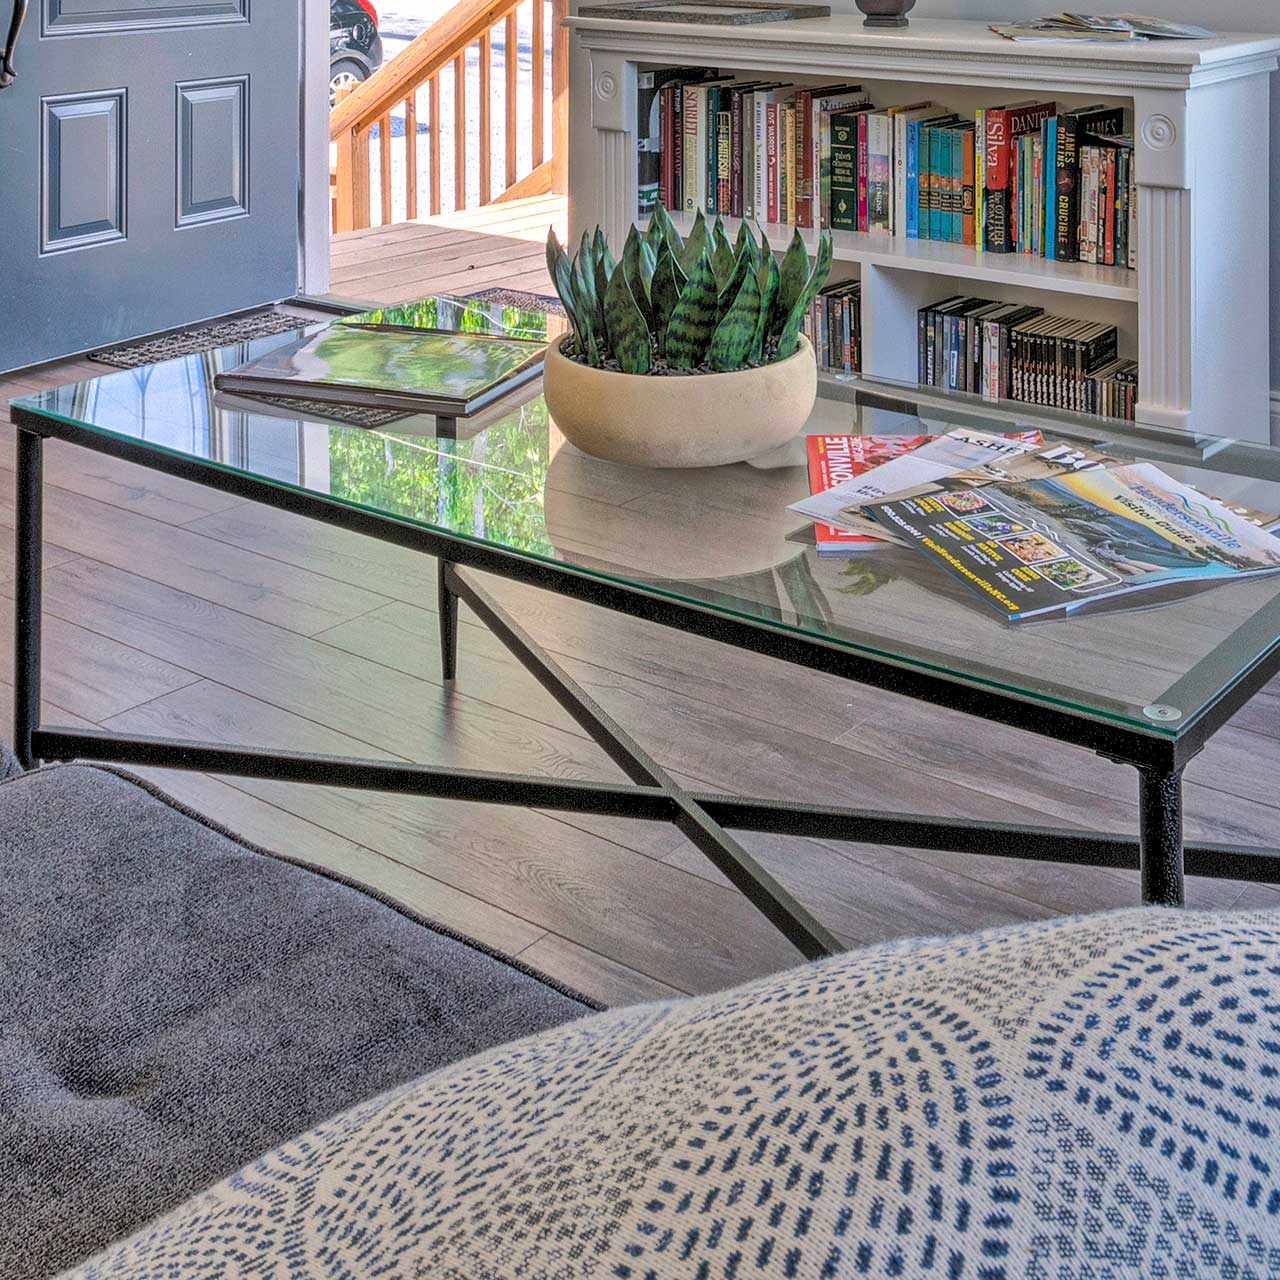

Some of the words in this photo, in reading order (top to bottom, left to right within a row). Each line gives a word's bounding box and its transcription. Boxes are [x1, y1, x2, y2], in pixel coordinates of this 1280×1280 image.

[684, 89, 698, 136] SCARLETT
[767, 108, 775, 125] LOVE
[718, 139, 729, 179] PATTERSON
[767, 125, 775, 155] WARRIOR
[796, 143, 804, 159] CODE
[987, 121, 1005, 169] Silva
[1057, 127, 1065, 168] ROLLINS
[1065, 132, 1075, 164] JAMES
[987, 194, 995, 241] WOMAN
[994, 204, 1005, 246] OTHER
[1058, 195, 1069, 244] CRUCIBLE
[1113, 494, 1155, 522] Visitor
[1155, 519, 1197, 546] Guide
[1129, 482, 1241, 550] Hendersonville
[922, 537, 1021, 612] VisitHendersonvilleNC.org
